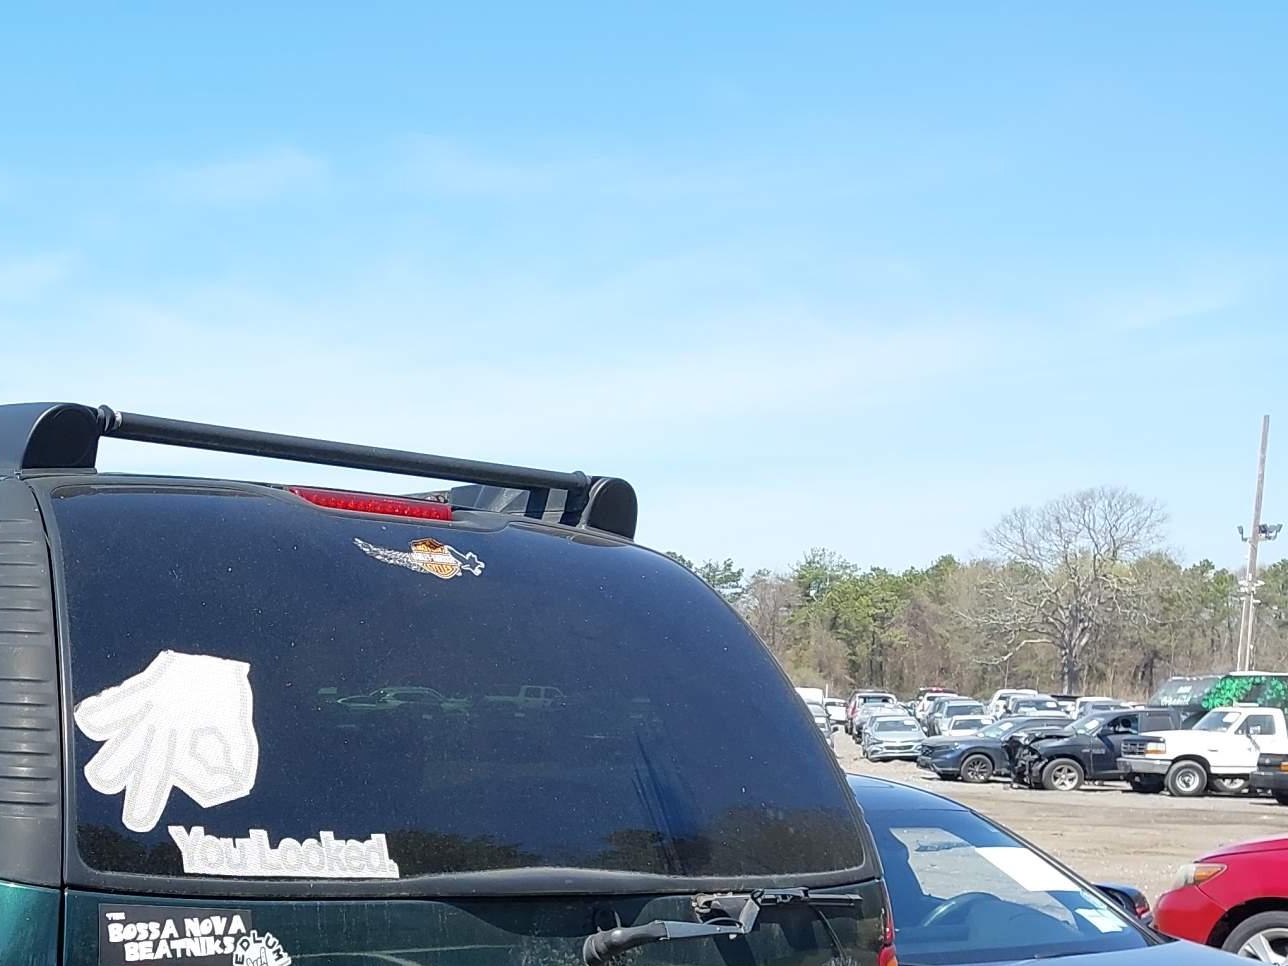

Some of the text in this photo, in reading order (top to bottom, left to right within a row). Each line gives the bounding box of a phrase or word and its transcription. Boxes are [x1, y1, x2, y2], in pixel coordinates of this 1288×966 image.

[170, 826, 248, 873] You
[108, 914, 247, 943] BOSSA NOVA
[124, 935, 236, 962] BEATNIKS
